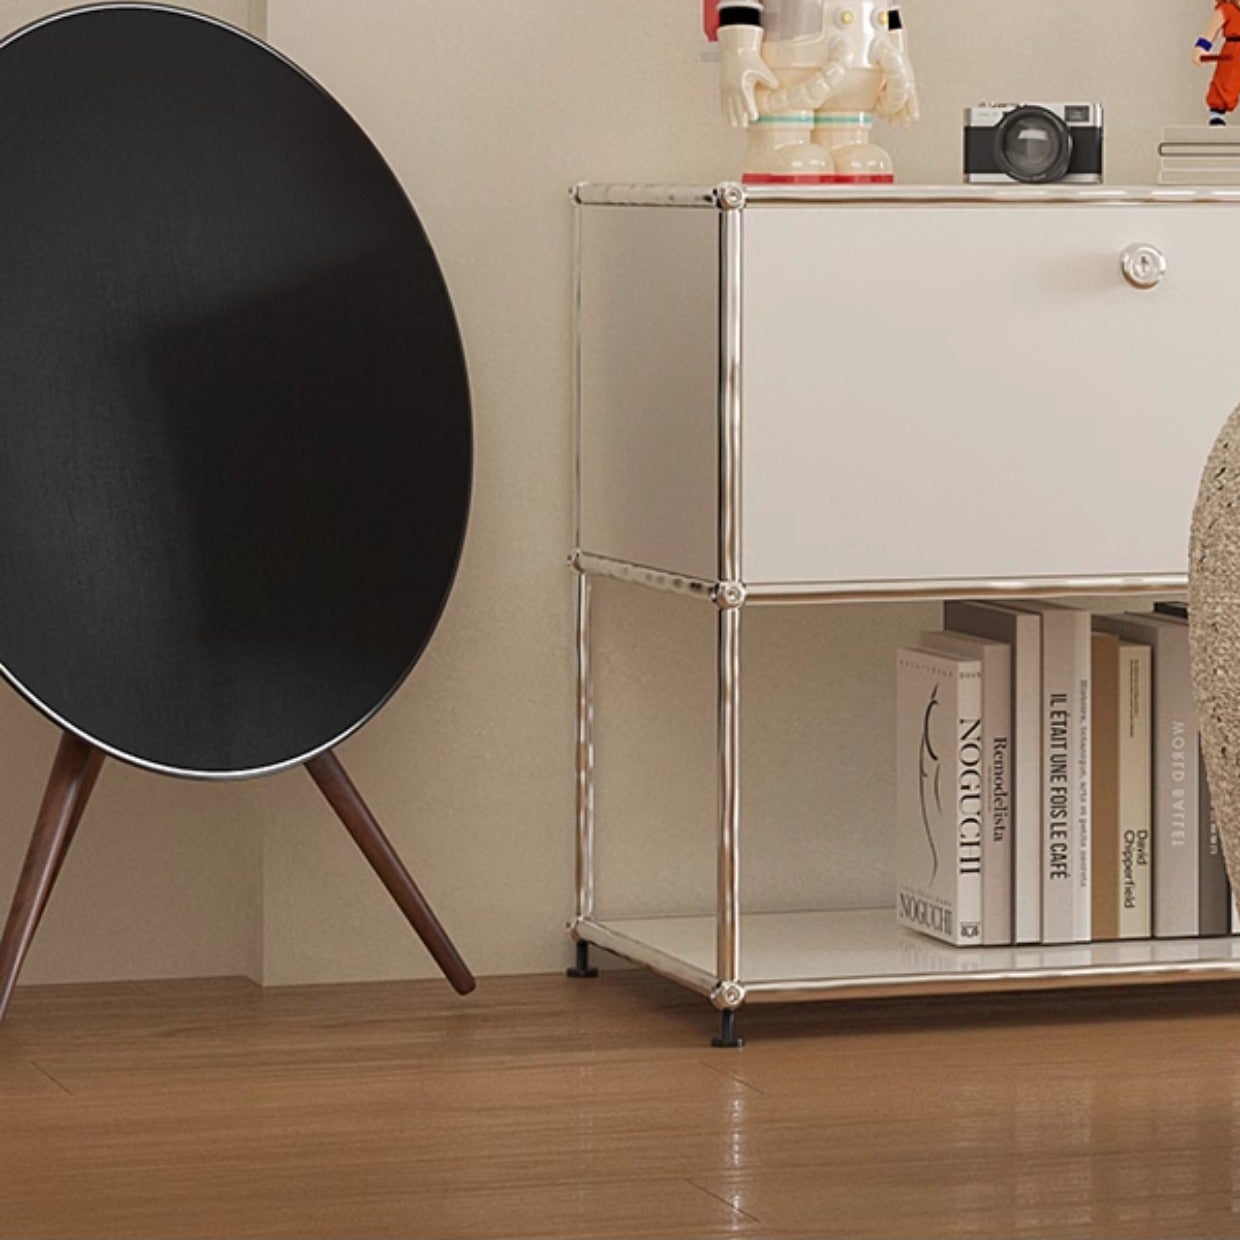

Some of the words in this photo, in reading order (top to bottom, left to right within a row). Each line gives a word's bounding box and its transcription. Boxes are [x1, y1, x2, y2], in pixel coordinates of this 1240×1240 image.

[1050, 693, 1067, 707] IL
[1050, 710, 1070, 749] ÉTAIT
[1050, 753, 1067, 784] UNE
[959, 718, 982, 874] NOGUCHI
[993, 736, 1008, 842] Remodelista
[1050, 786, 1067, 820] FOIS
[1050, 821, 1067, 840] LE
[1136, 829, 1148, 866] David
[1050, 842, 1070, 880] CAFÉ
[1123, 830, 1136, 909] Chipperfield
